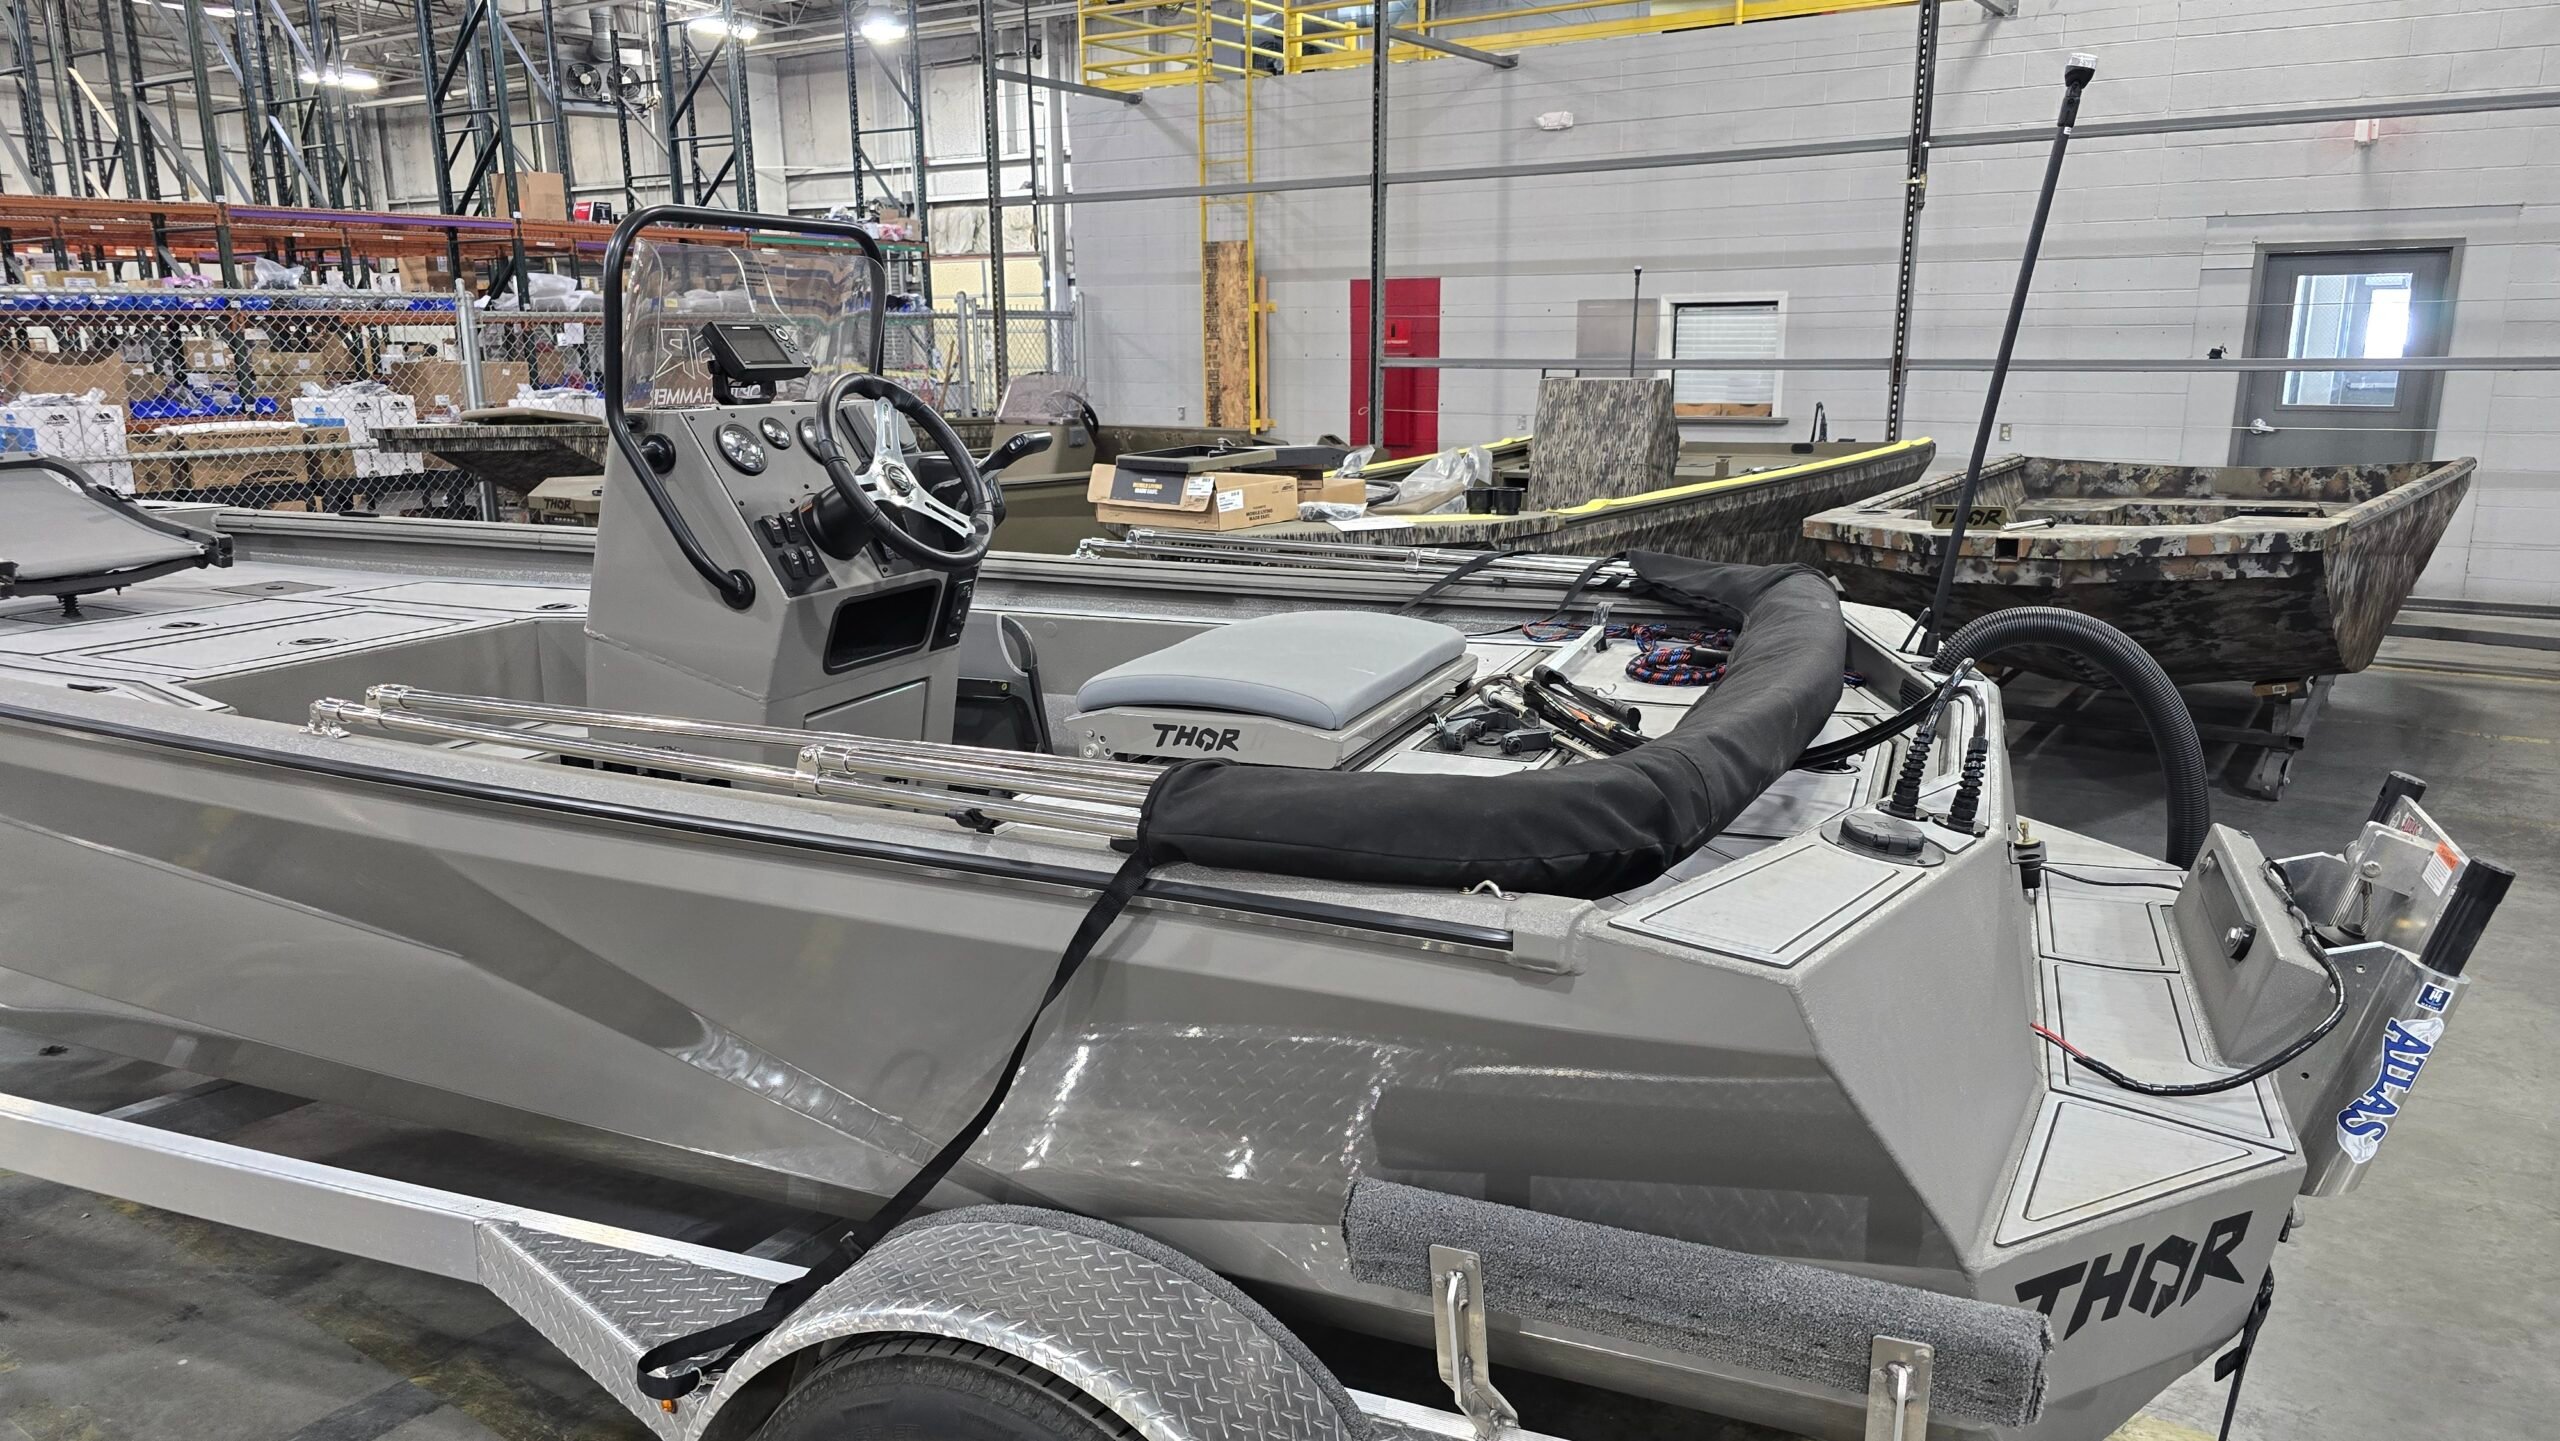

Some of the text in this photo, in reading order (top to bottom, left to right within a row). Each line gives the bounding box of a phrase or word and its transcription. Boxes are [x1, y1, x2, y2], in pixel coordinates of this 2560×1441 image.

[543, 498, 572, 511] THOR
[1152, 723, 1241, 752] THOR
[2337, 1019, 2433, 1143] ATLAS
[2014, 1210, 2254, 1342] THOR
